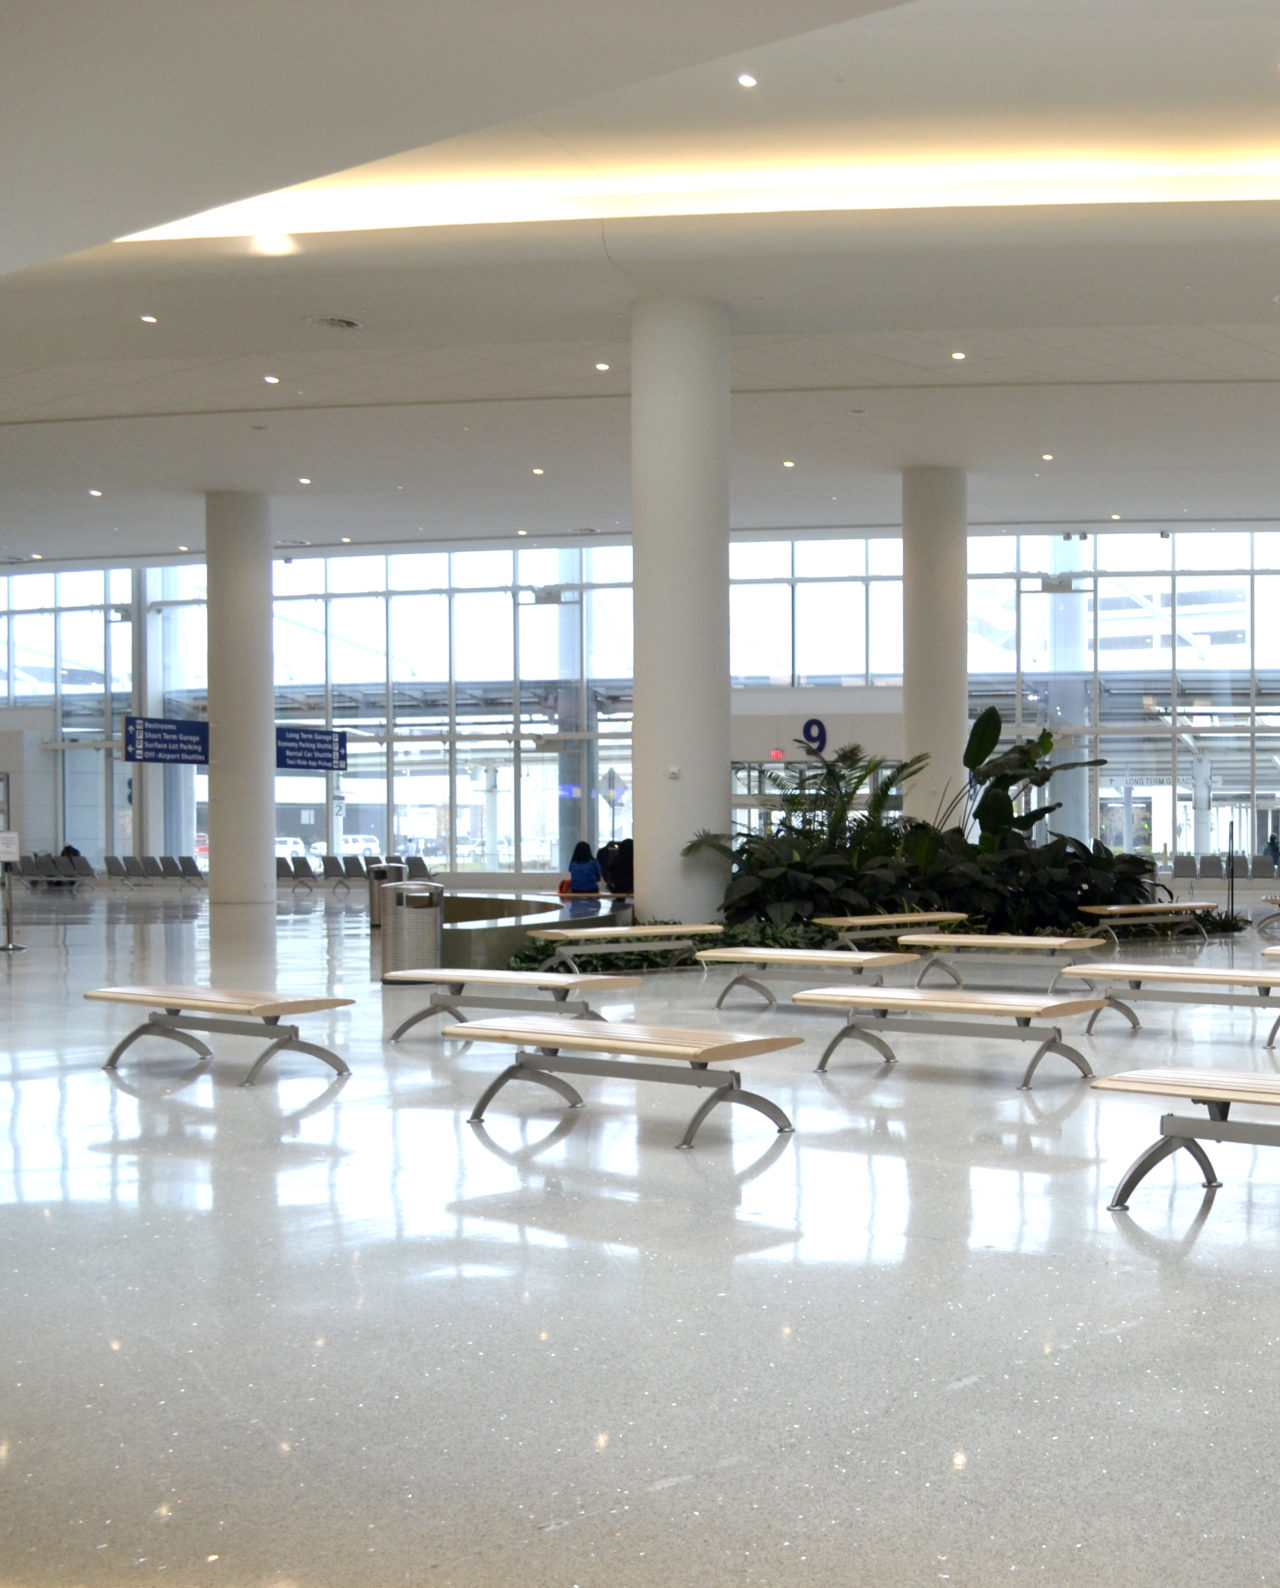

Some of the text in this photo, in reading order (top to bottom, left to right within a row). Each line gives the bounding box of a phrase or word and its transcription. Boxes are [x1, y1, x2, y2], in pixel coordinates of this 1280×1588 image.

[179, 734, 200, 742] Garage
[803, 719, 826, 753] 9
[180, 743, 202, 752] Parking
[335, 805, 342, 816] 2
